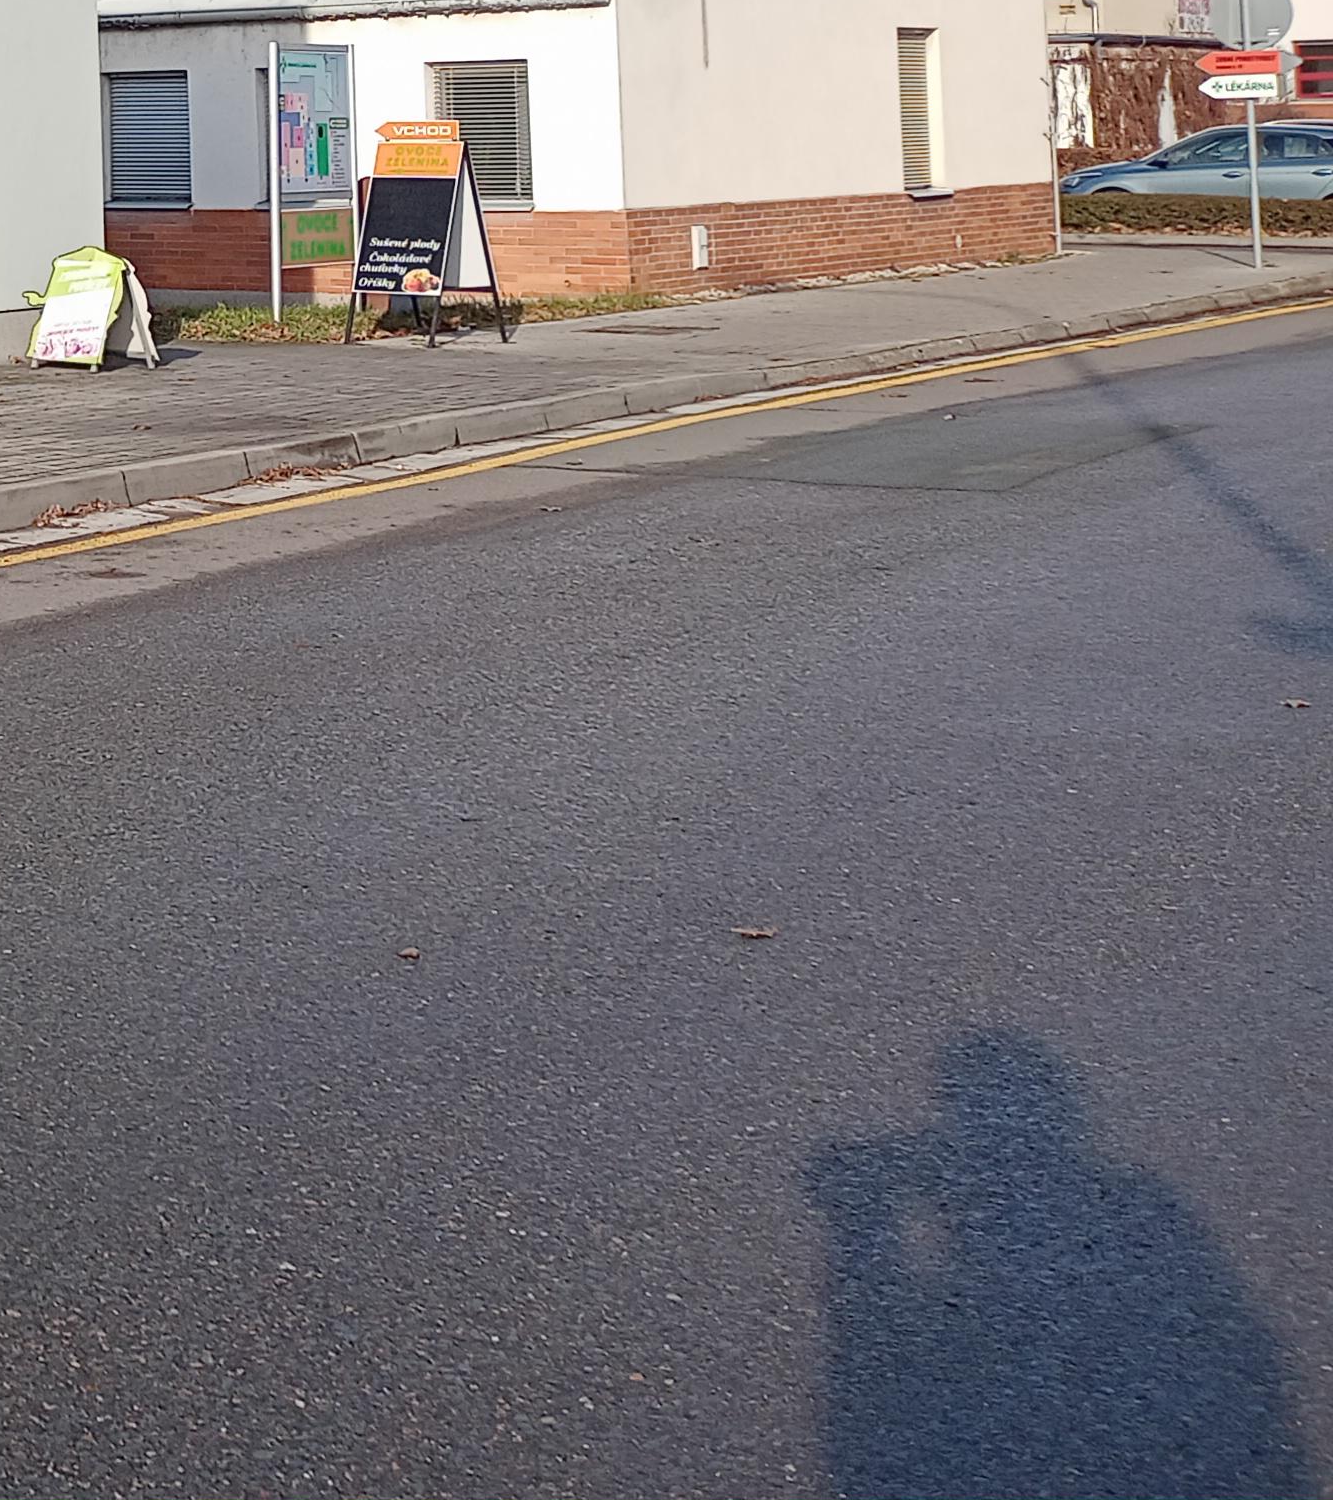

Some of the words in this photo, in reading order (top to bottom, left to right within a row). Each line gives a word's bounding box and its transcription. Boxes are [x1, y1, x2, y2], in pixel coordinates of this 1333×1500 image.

[1225, 80, 1274, 92] LÉKÁRNA
[391, 126, 452, 136] VCHOD
[395, 146, 442, 156] OVOCE
[385, 157, 449, 167] ZELENINA
[296, 214, 339, 234] OVOCE
[369, 236, 408, 248] Sušené
[409, 238, 441, 251] plody
[290, 241, 346, 261] ZELENINA
[368, 250, 433, 263] Čokoládové
[358, 276, 397, 290] Oříšky
